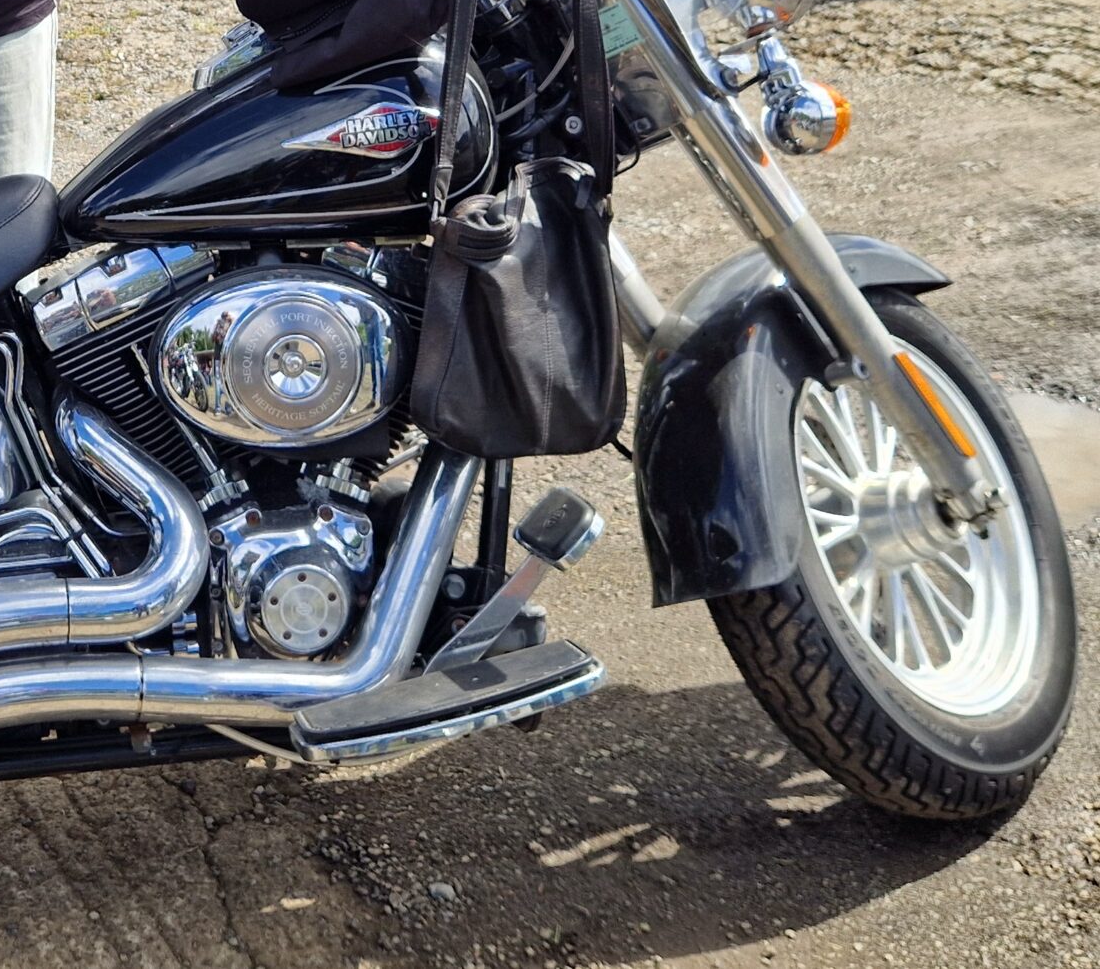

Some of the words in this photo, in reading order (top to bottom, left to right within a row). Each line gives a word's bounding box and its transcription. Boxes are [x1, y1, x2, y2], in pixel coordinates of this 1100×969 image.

[341, 121, 431, 148] DAVIDSON
[242, 318, 280, 384] SEQUENTIAL
[280, 312, 313, 323] PORT
[314, 317, 349, 370] INJECTION
[251, 392, 307, 421] HERITAGE
